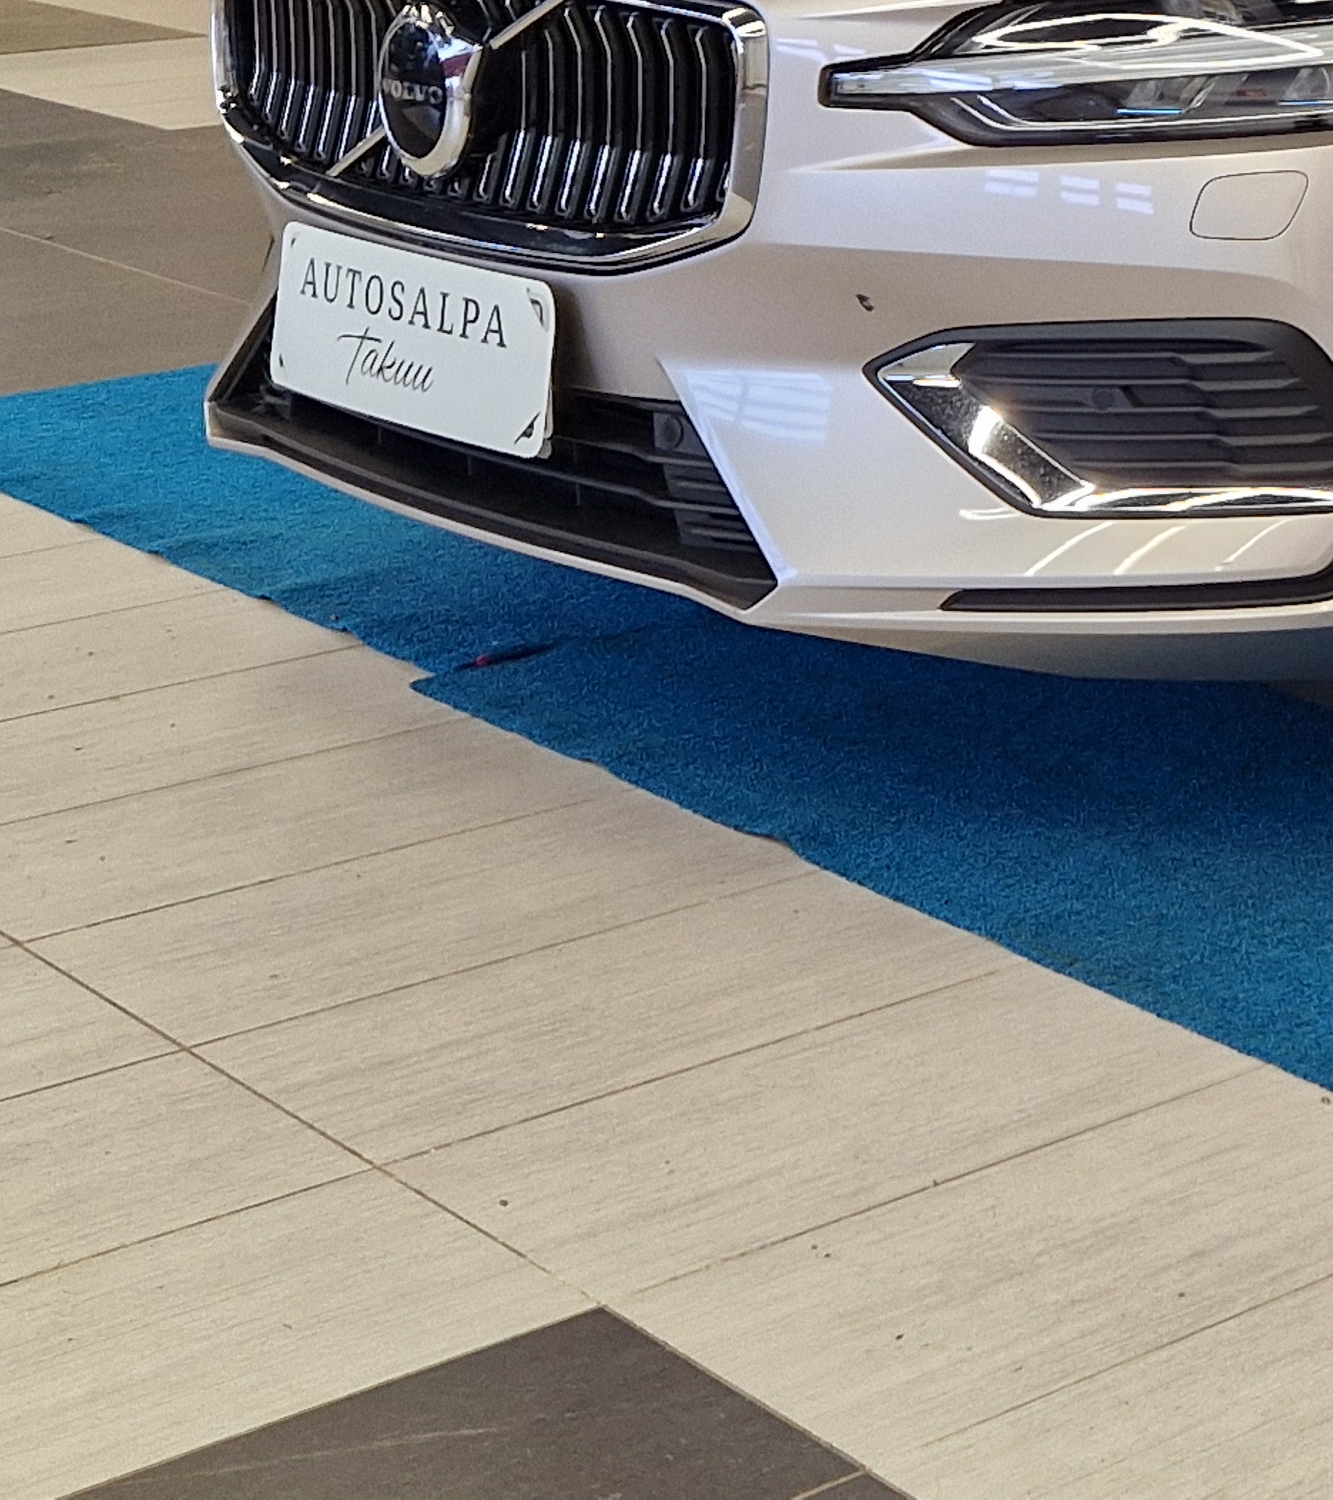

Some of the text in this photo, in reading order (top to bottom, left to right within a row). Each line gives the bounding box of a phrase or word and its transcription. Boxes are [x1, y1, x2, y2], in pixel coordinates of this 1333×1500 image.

[382, 78, 443, 104] VOLVO
[300, 257, 508, 348] AUTOSALPA
[337, 326, 435, 392] Takuu
